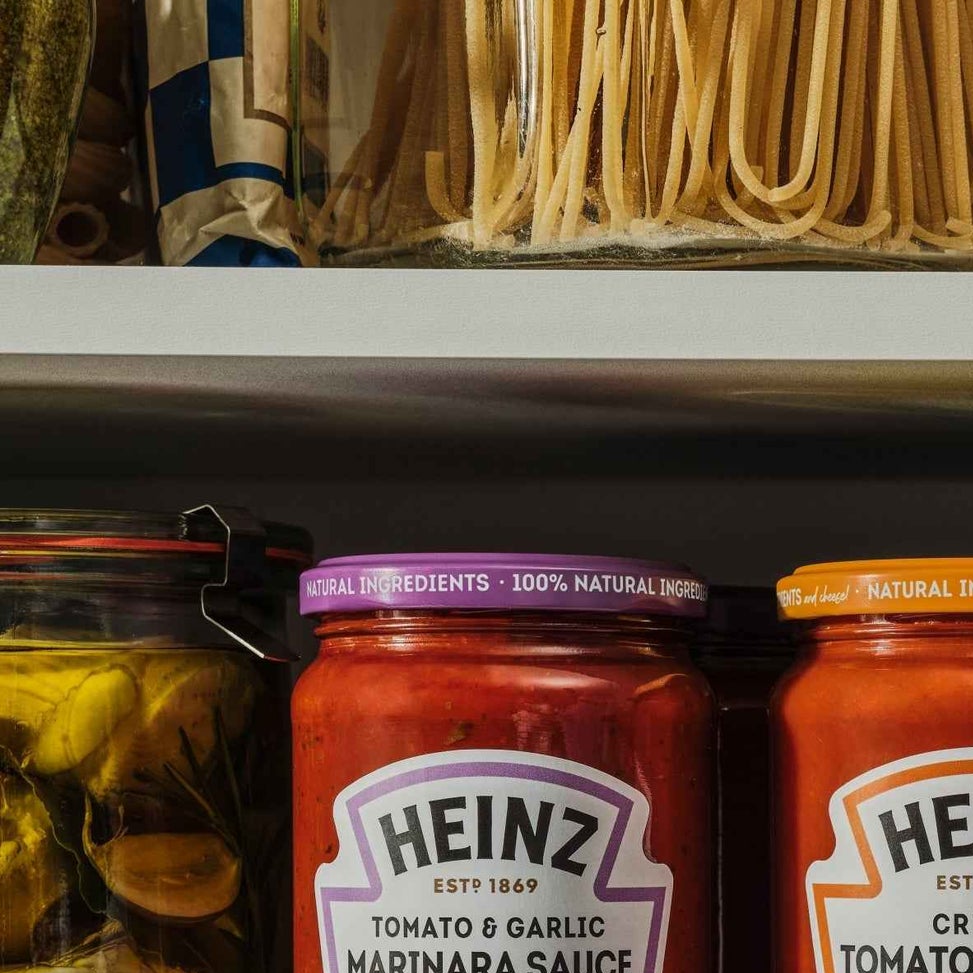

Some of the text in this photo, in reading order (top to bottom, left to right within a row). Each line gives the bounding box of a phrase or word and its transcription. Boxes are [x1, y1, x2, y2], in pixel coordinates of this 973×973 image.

[306, 577, 355, 598] NATURAL
[360, 573, 490, 595] INGREDIENTS
[512, 573, 568, 592] 100%
[574, 573, 656, 595] NATURAL
[803, 585, 819, 607] and
[868, 580, 952, 600] NATURAL
[378, 795, 599, 877] HEINZ
[489, 878, 539, 894] 1869
[371, 916, 605, 939] TOMATO & GARLIC
